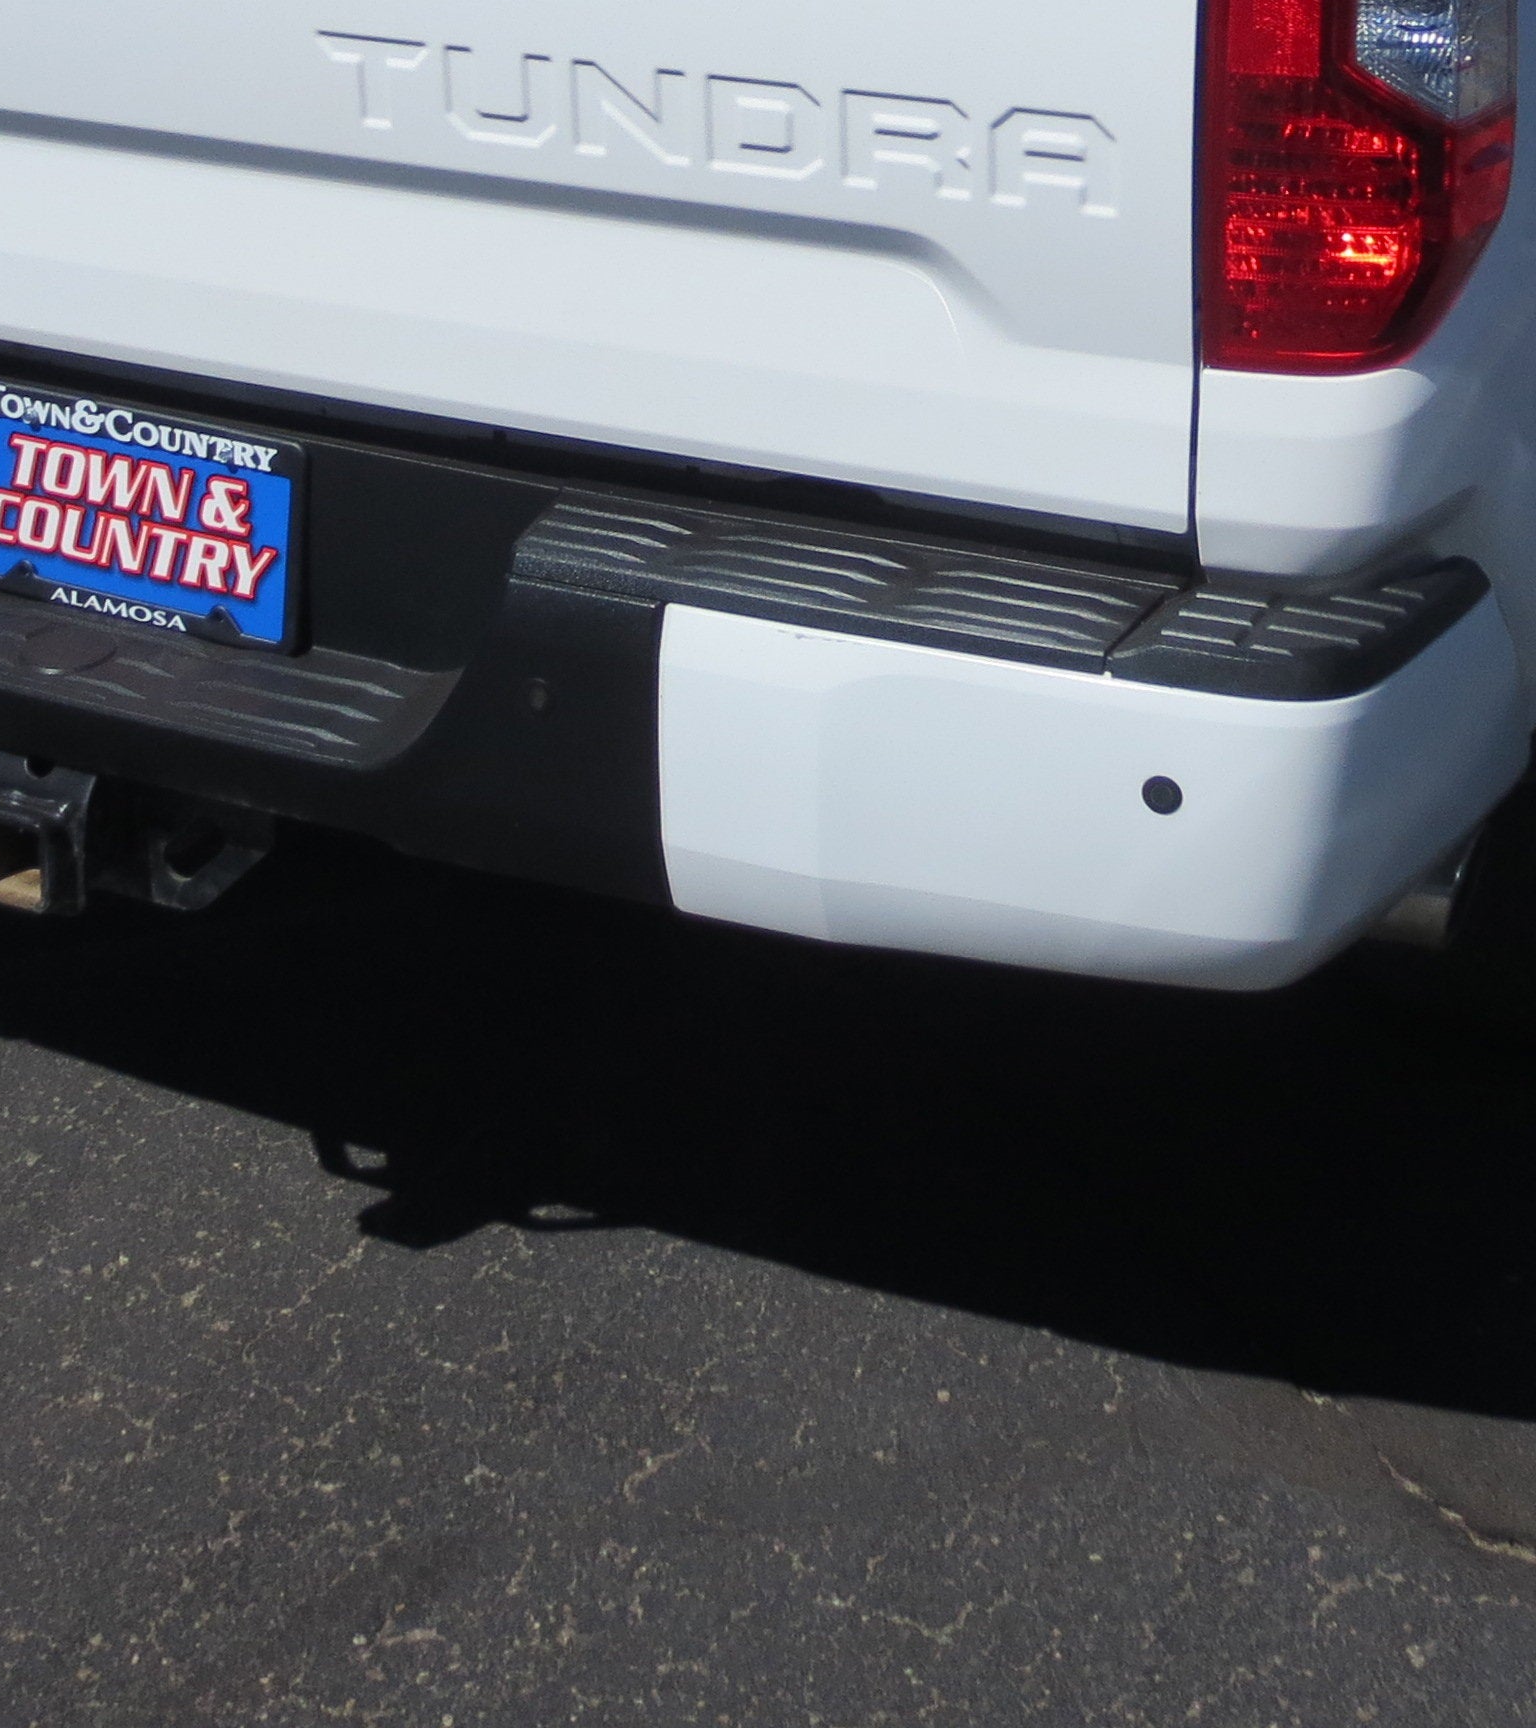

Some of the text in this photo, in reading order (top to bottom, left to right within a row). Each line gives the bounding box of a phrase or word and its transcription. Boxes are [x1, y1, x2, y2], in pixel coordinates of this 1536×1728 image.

[315, 27, 1120, 219] TUNDRA
[8, 432, 253, 538] TOWN &
[50, 586, 187, 633] ALAMOSA
